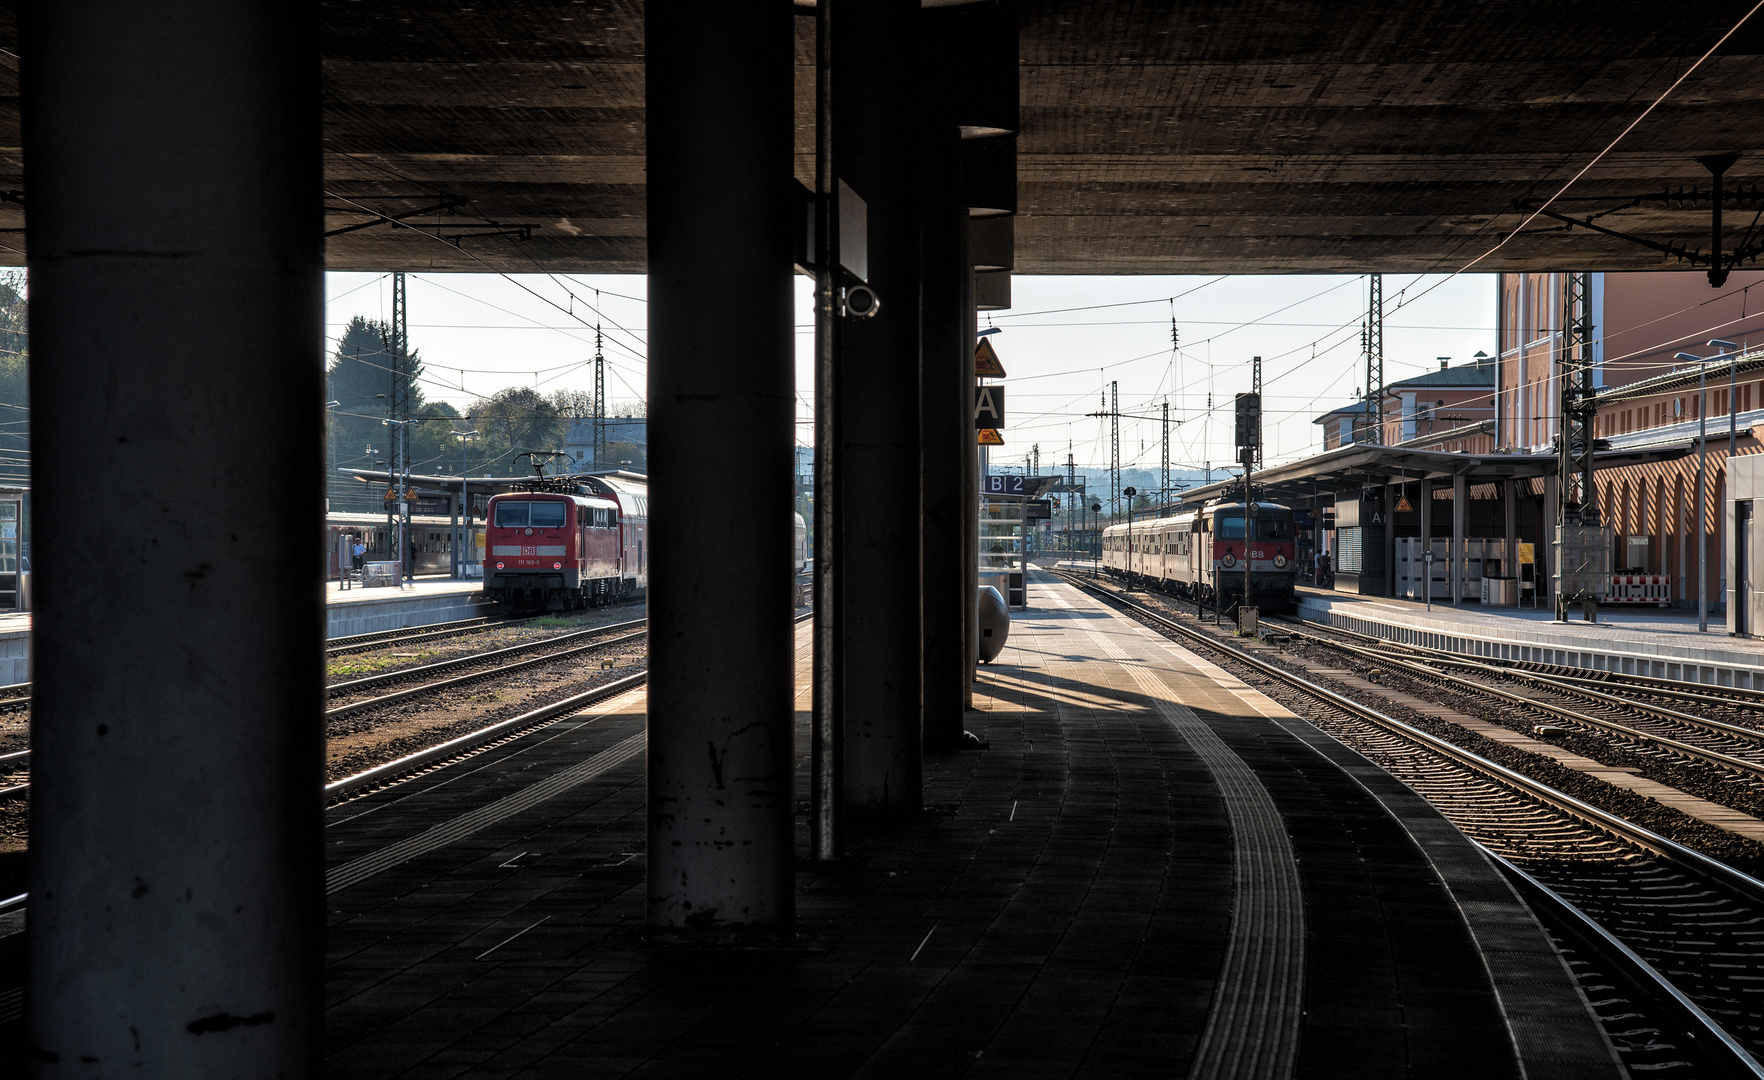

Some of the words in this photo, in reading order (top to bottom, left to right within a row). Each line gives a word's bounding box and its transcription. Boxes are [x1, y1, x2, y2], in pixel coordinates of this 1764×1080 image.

[974, 388, 999, 419] A
[991, 476, 1002, 491] B
[1013, 476, 1023, 491] 2
[1372, 512, 1381, 523] A
